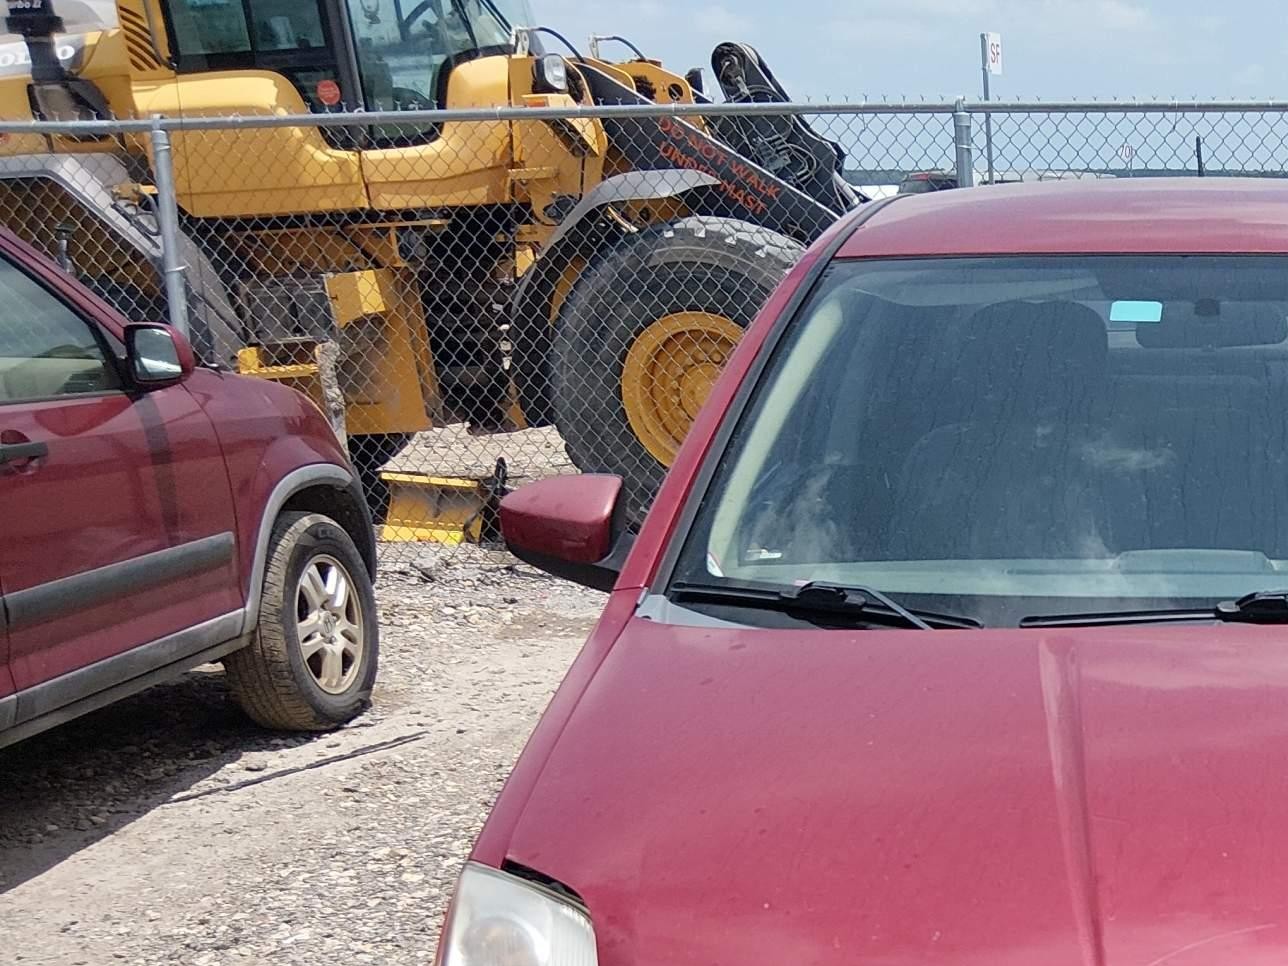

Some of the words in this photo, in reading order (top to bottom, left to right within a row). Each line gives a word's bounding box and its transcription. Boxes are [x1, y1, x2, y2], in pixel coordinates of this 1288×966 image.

[0, 45, 75, 66] OLO
[990, 42, 1000, 64] SF
[687, 133, 729, 165] NOT
[730, 160, 781, 198] WALK
